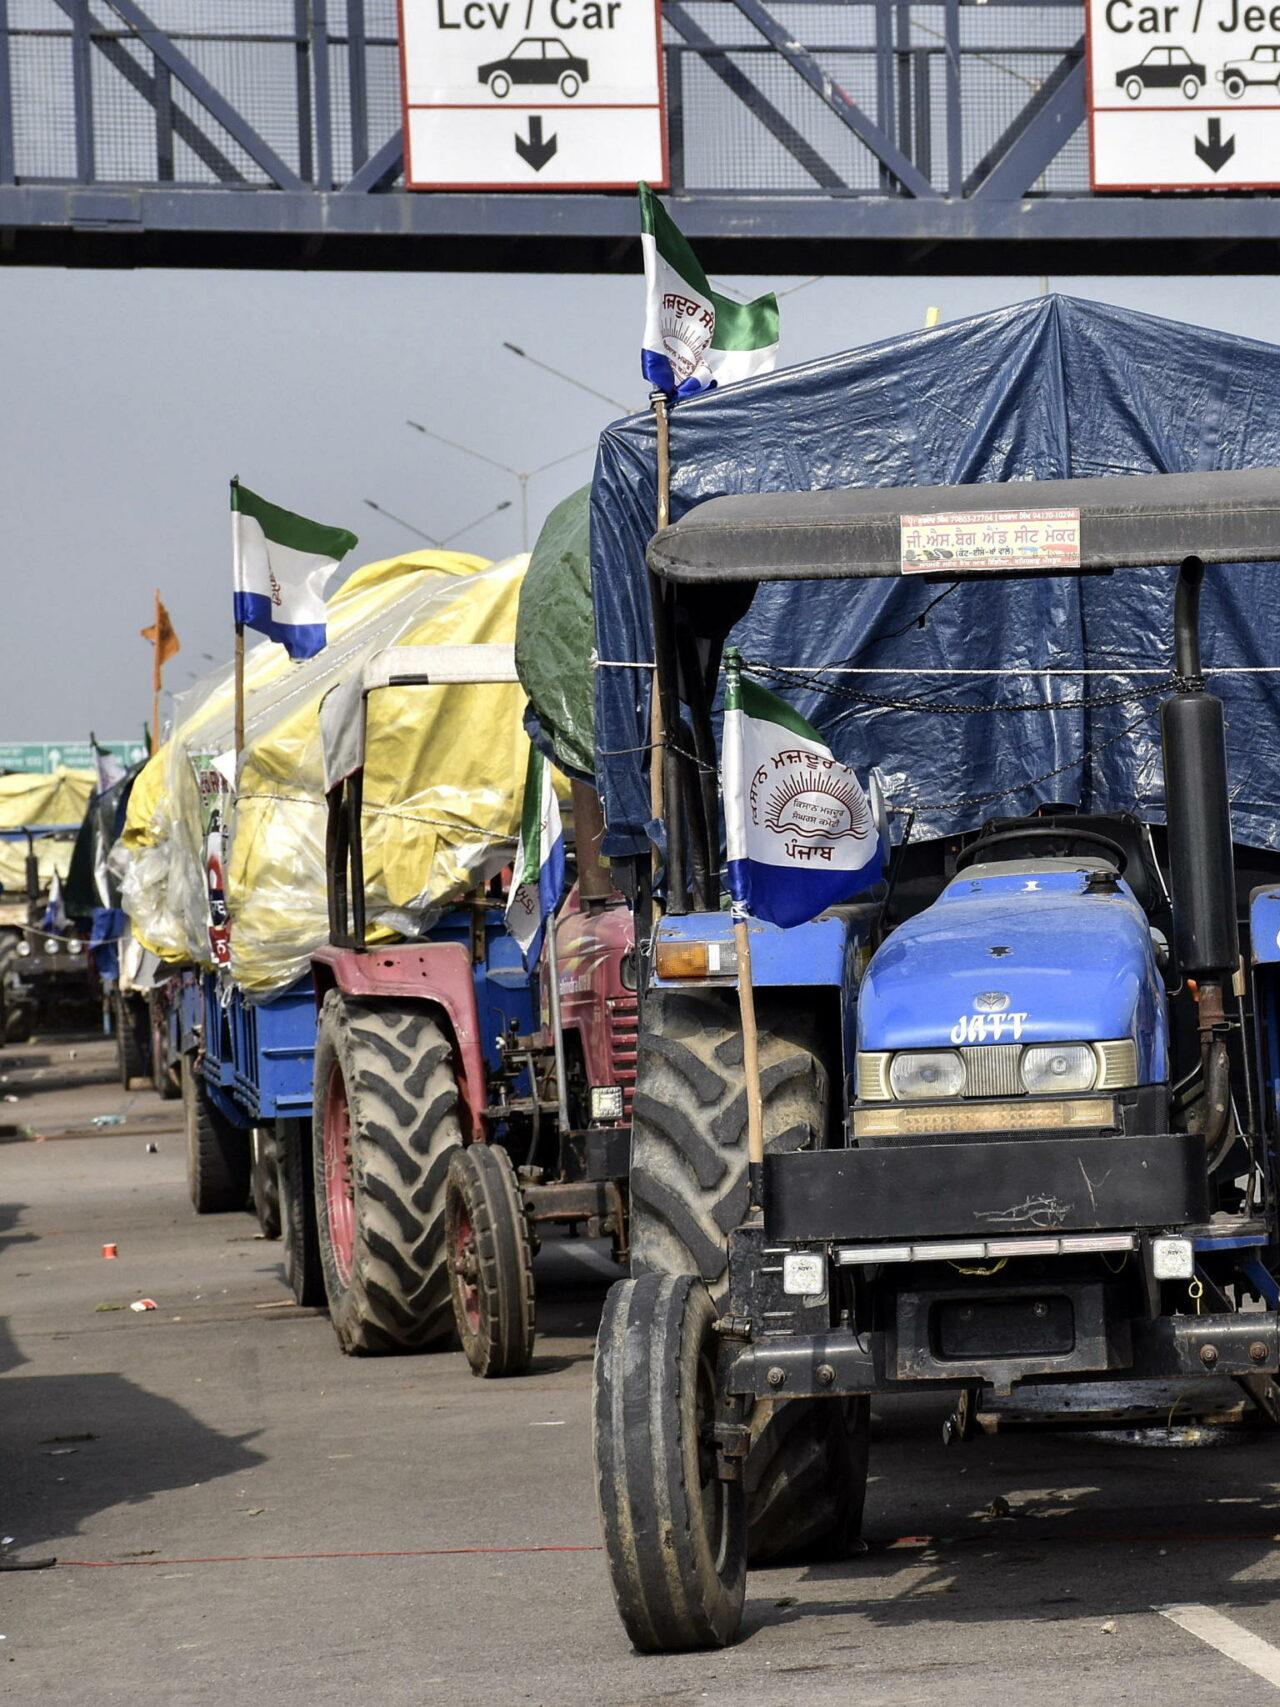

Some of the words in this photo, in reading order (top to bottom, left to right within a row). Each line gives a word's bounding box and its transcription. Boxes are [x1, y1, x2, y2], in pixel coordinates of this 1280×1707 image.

[437, 0, 510, 30] Lcv
[550, 0, 622, 30] Car
[1105, 0, 1179, 34] Car
[771, 749, 837, 770] ਮਜ਼ਦੂਰ
[784, 838, 836, 861] ਪੰਜਾਬ
[950, 1012, 1028, 1044] JATT
